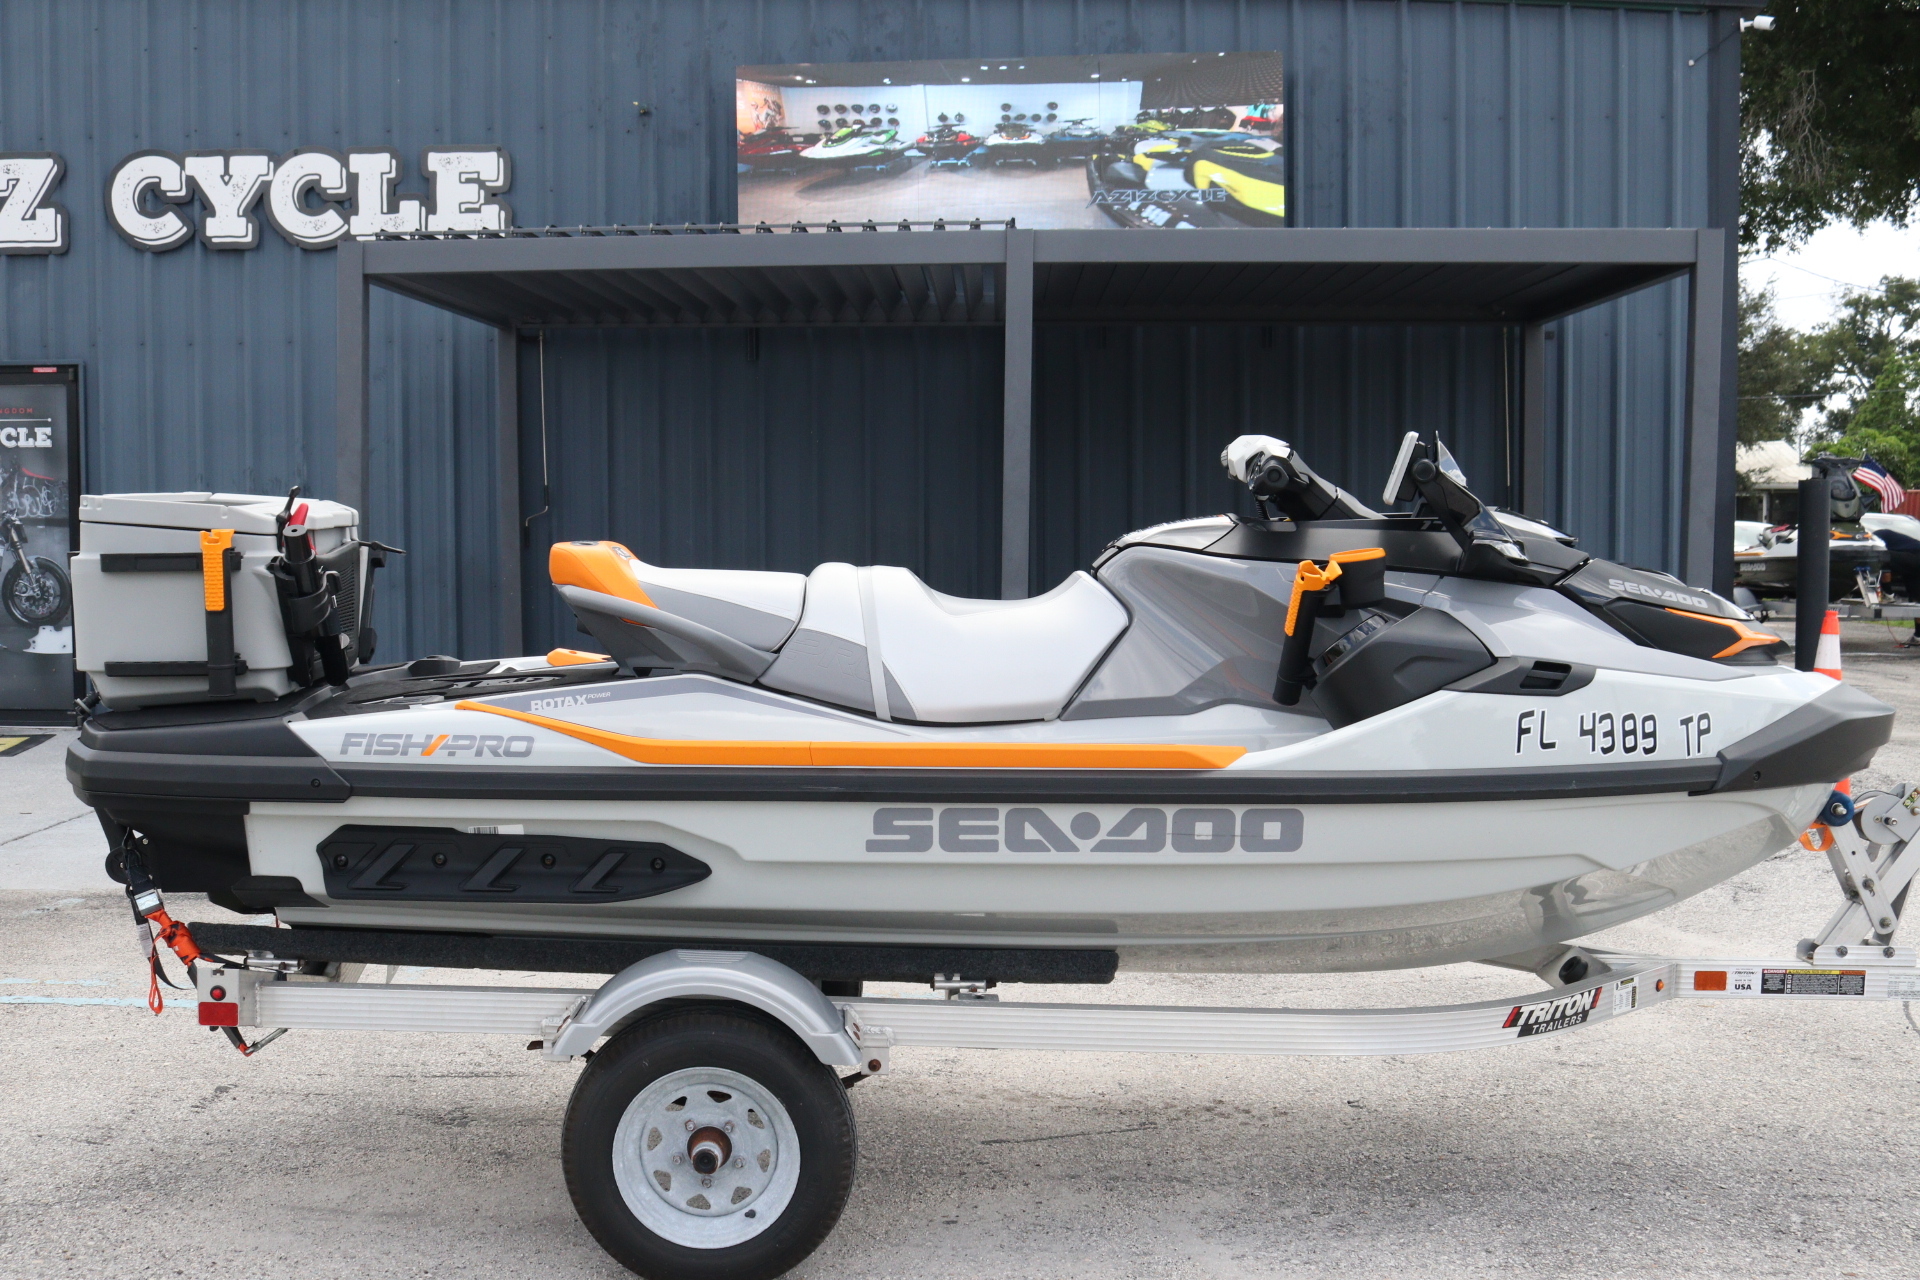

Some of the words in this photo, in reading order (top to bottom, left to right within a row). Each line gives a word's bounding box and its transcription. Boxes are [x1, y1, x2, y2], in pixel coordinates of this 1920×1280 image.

[0, 156, 62, 248] Z
[110, 150, 507, 245] CYCLE
[0, 426, 53, 448] CLE
[530, 694, 588, 712] ROTAX
[587, 691, 612, 700] POWER
[1516, 708, 1557, 755] FL
[1578, 710, 1658, 756] 4389
[1678, 710, 1712, 758] TP
[1734, 983, 1752, 991] USA
[1517, 989, 1596, 1027] TRITON
[1531, 1013, 1583, 1036] TRAILERS
